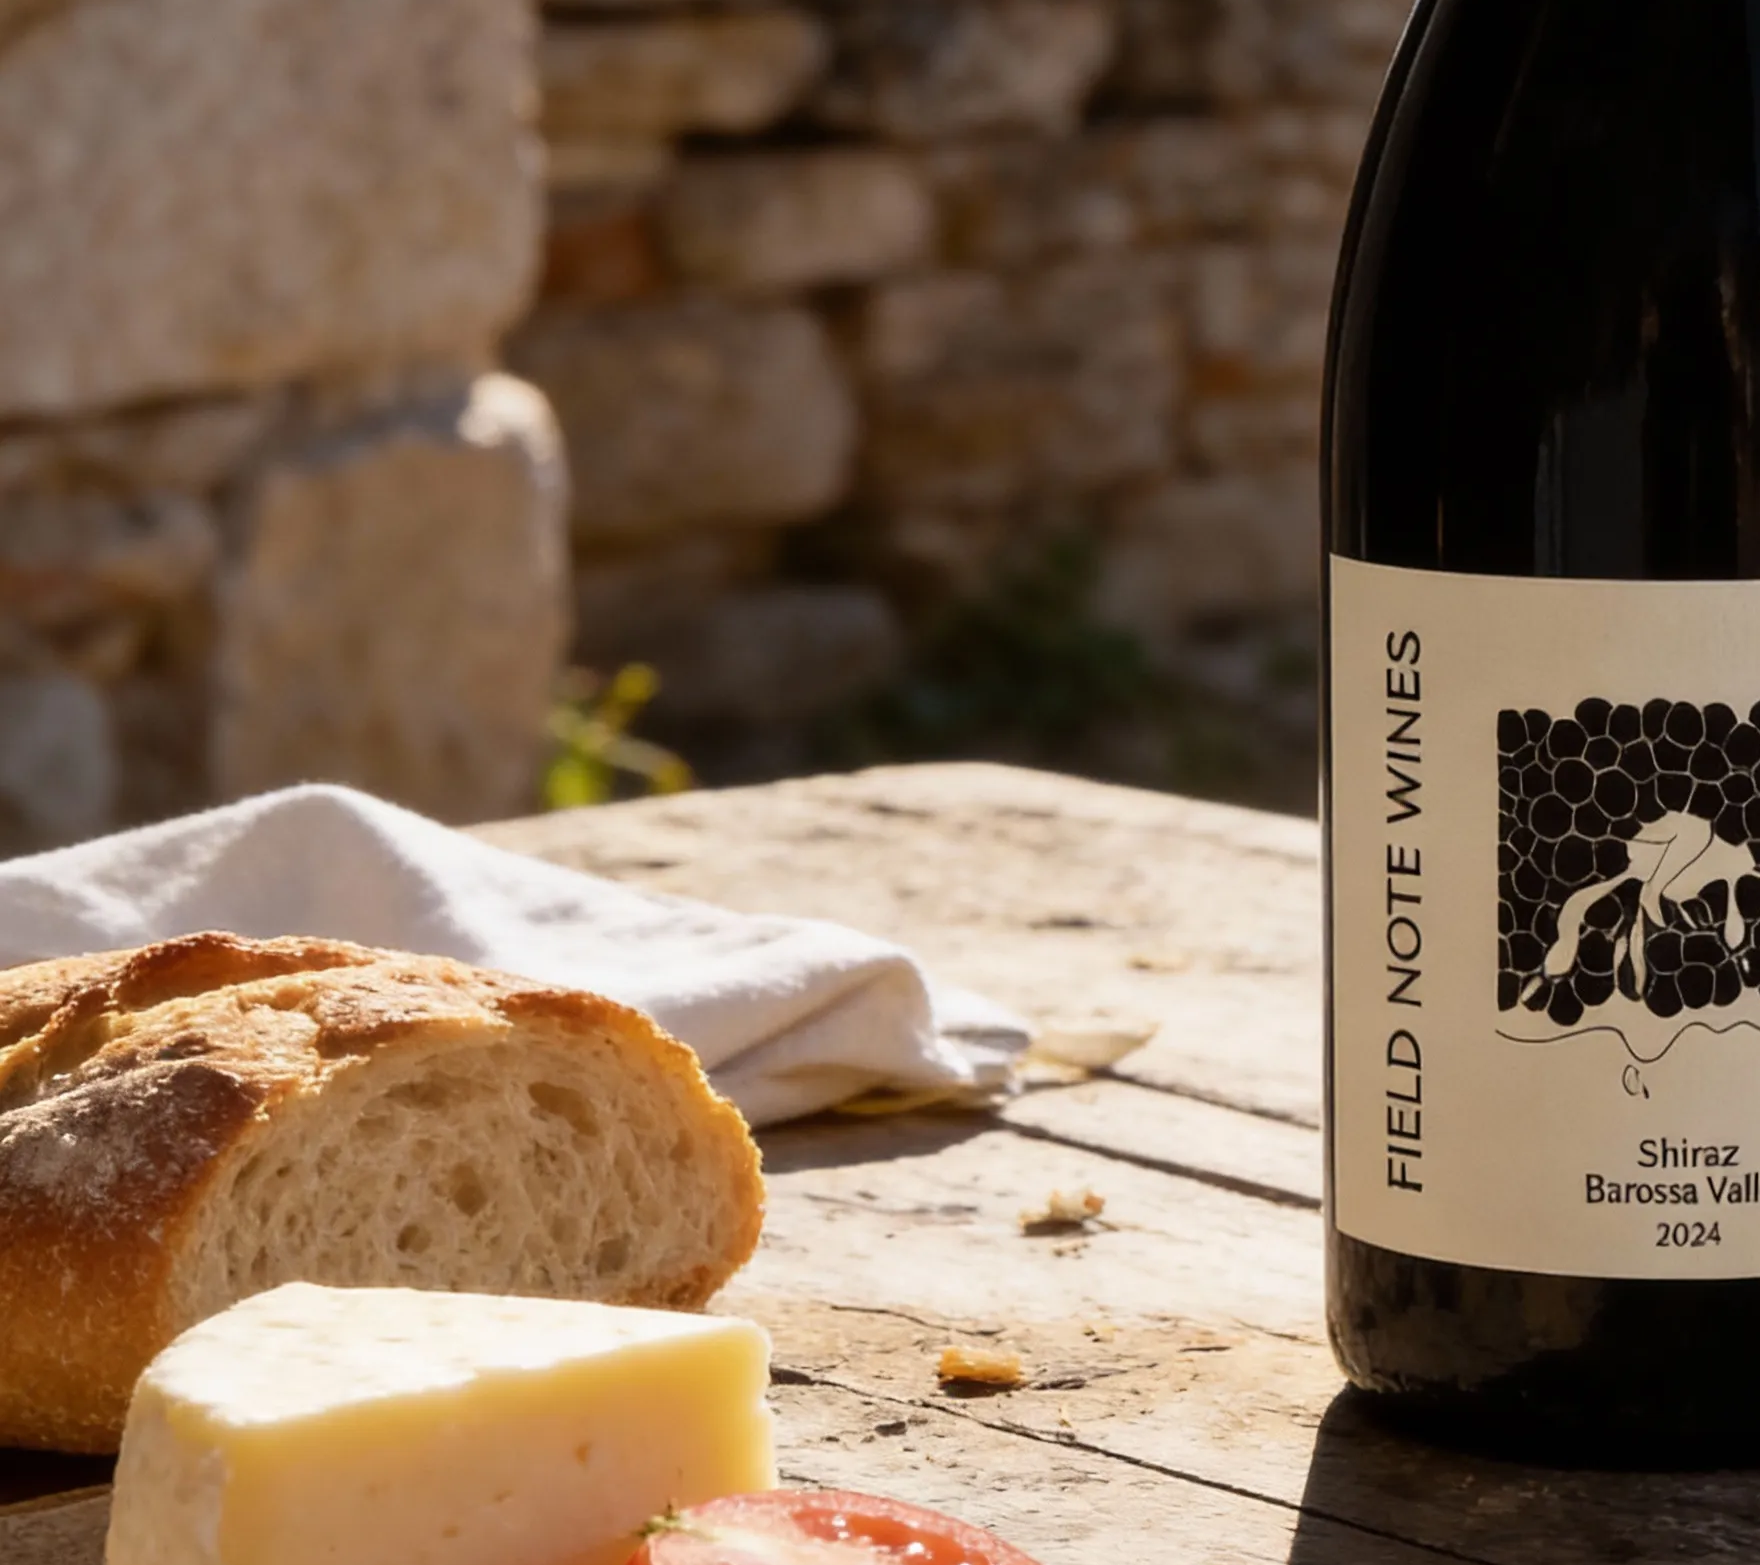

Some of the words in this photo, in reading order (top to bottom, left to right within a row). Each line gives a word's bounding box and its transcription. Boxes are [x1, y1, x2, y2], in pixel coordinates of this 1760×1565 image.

[1386, 631, 1422, 824] WINES
[1386, 844, 1422, 1007] NOTE
[1386, 1029, 1422, 1193] FIELD
[1637, 1137, 1739, 1168] Shiraz
[1586, 1174, 1698, 1204] Barossa
[1656, 1221, 1721, 1247] 2024
